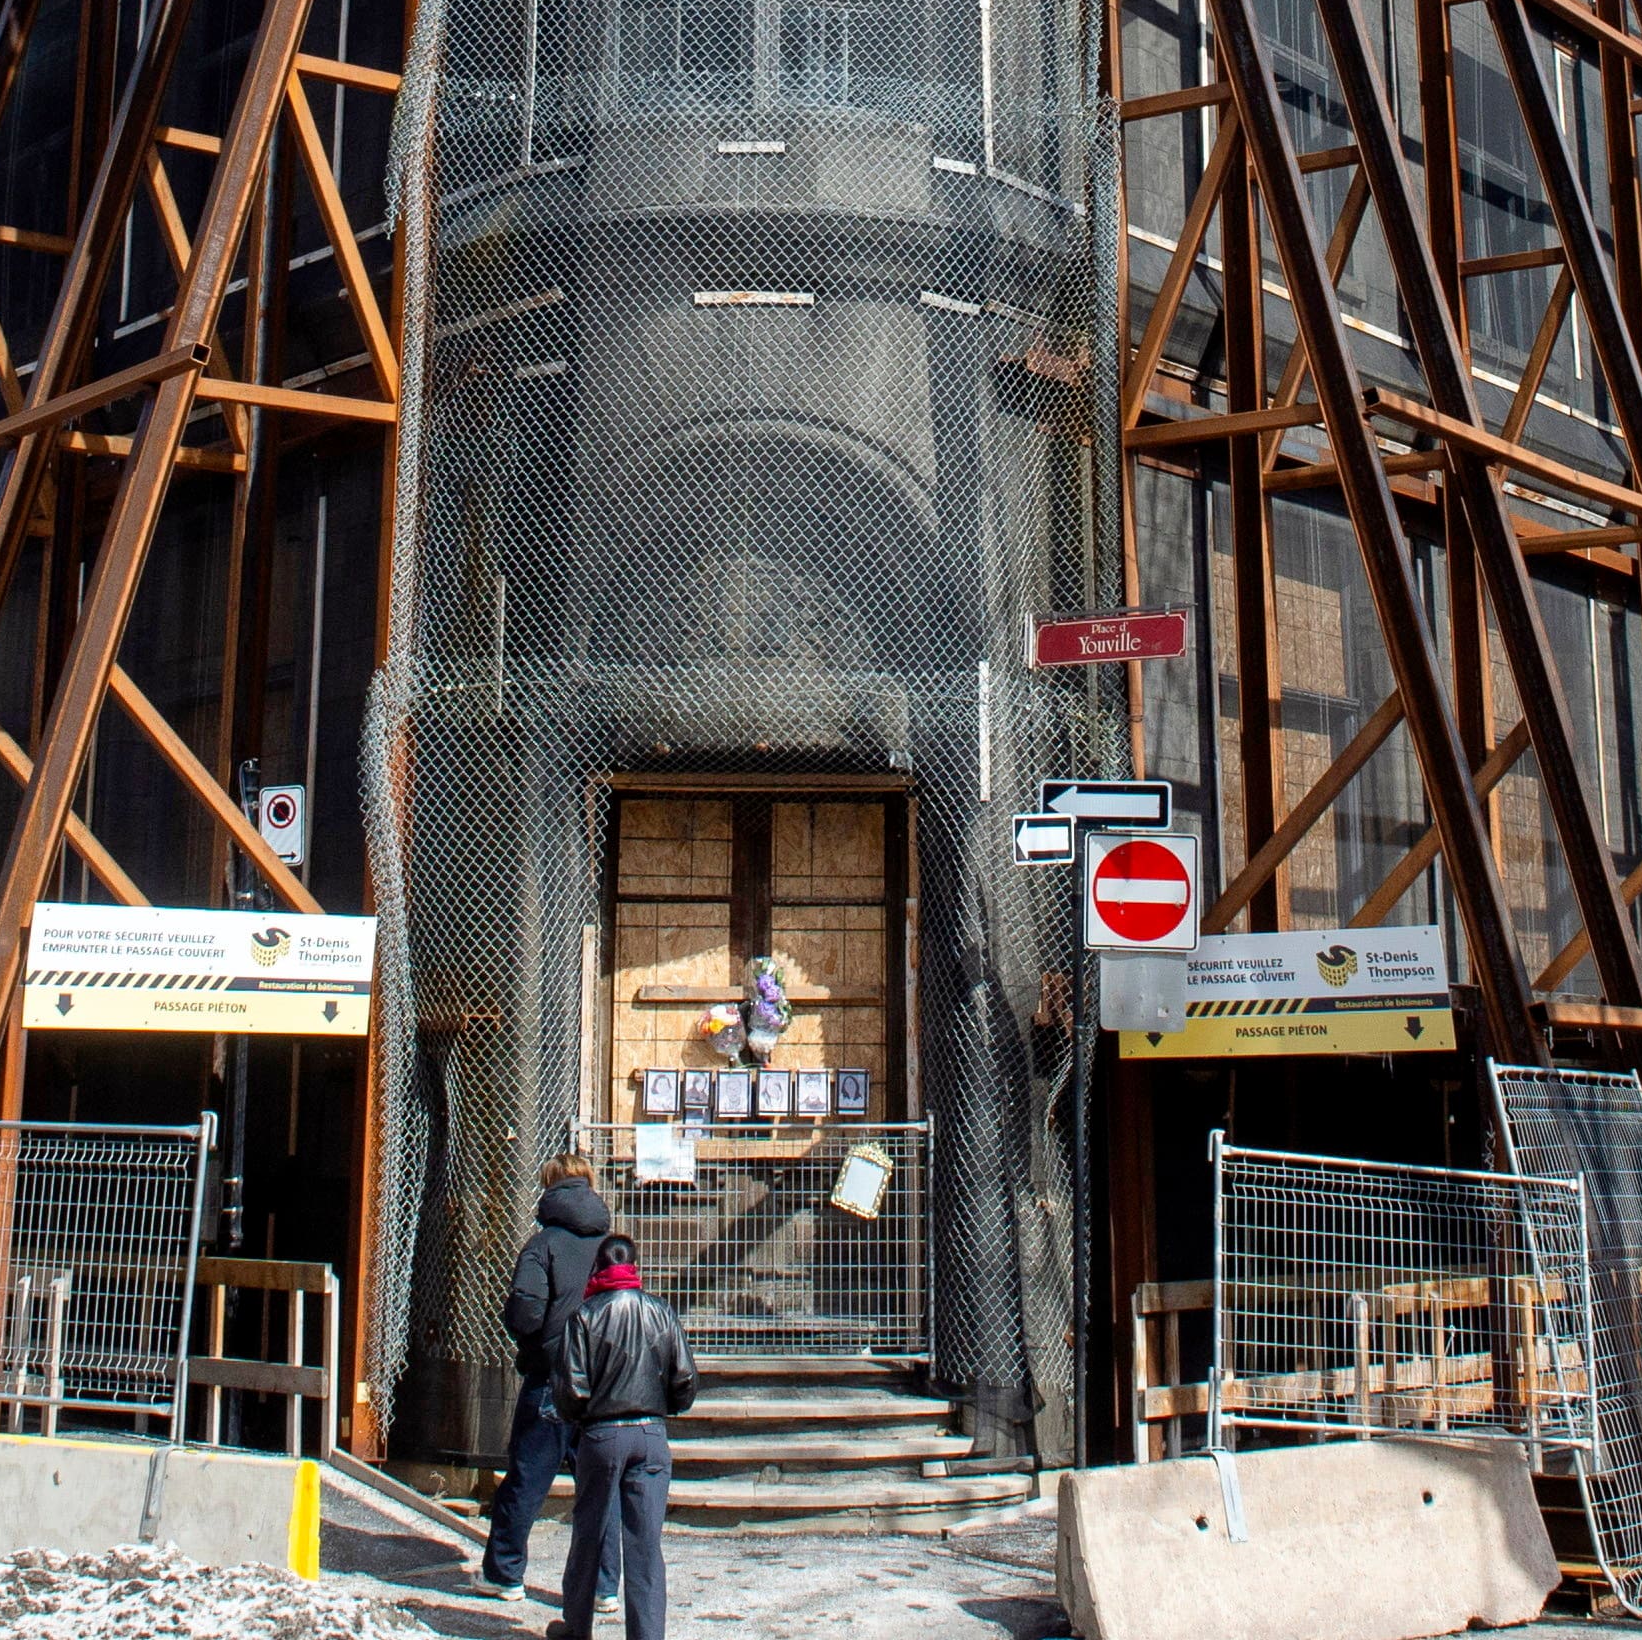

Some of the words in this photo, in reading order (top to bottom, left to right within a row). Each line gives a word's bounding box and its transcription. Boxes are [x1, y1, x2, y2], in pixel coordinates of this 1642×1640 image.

[1091, 623, 1116, 634] Place
[1078, 632, 1141, 655] Youville
[44, 928, 74, 939] POUR
[77, 930, 111, 940] VOTRE
[168, 933, 216, 944] VEUILLEZ
[300, 936, 350, 948] St-Denis
[42, 943, 108, 954] EMPRUNTER
[111, 945, 123, 955] LE
[126, 946, 174, 957] PASSAGE
[178, 948, 226, 958] COUVERT
[298, 950, 362, 964] Thompson
[1365, 950, 1418, 963] St-Denis
[1187, 959, 1234, 972] SÉCURITÉ
[1237, 958, 1283, 969] VEUILLEZ
[1187, 975, 1198, 986] LE
[1201, 974, 1247, 985] PASSAGE
[1249, 971, 1296, 983] COUVERT
[1367, 966, 1435, 979] Thompson
[154, 1001, 204, 1012] PASSAGE
[208, 1001, 247, 1013] PIÉTON
[1235, 1026, 1285, 1038] PASSAGE
[1288, 1024, 1328, 1037] PIÉTON
